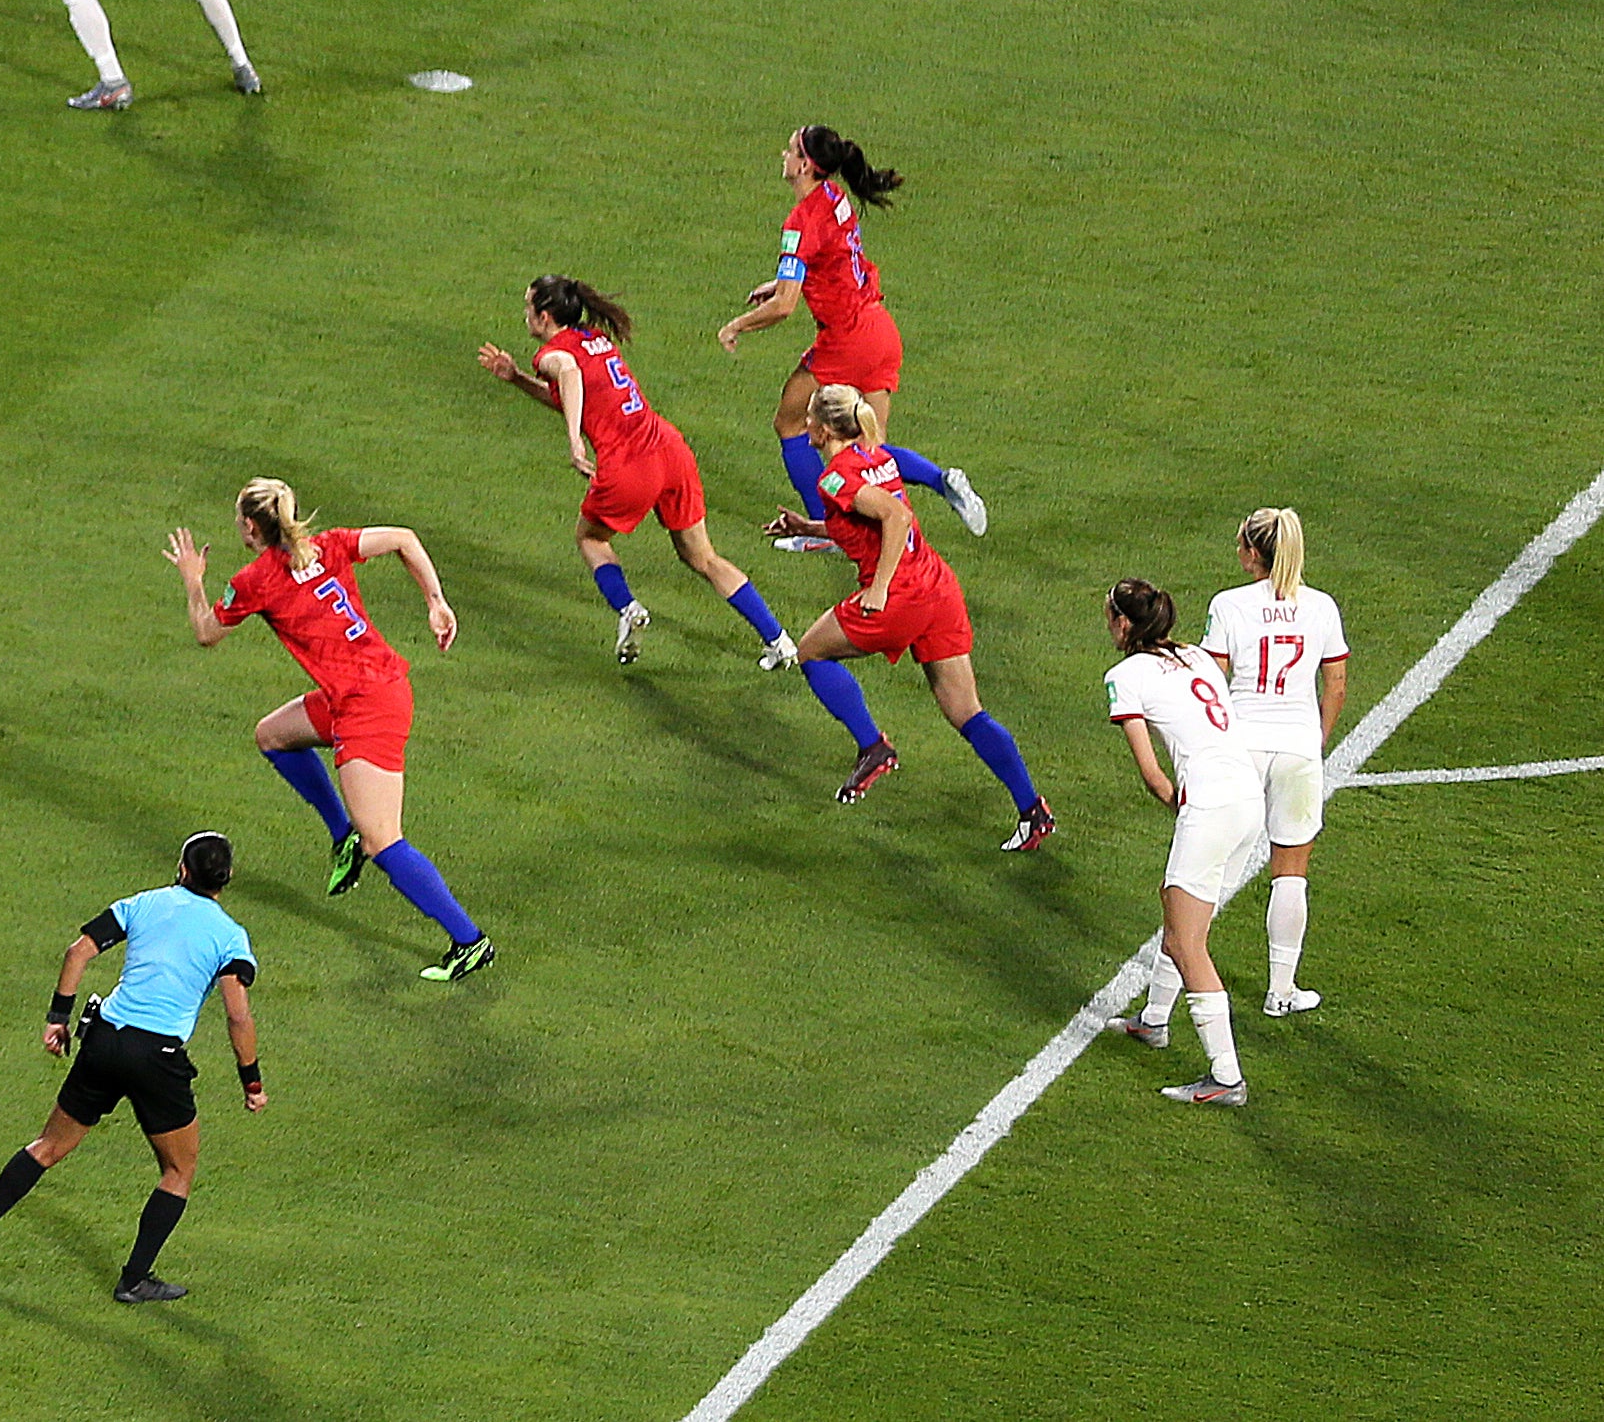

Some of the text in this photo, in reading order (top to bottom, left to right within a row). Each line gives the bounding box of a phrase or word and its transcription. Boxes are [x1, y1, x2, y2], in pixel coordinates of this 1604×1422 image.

[605, 356, 644, 414] 5
[313, 577, 368, 641] 3
[1262, 605, 1298, 623] DALY
[1256, 634, 1305, 695] 17
[1190, 677, 1229, 732] 8
